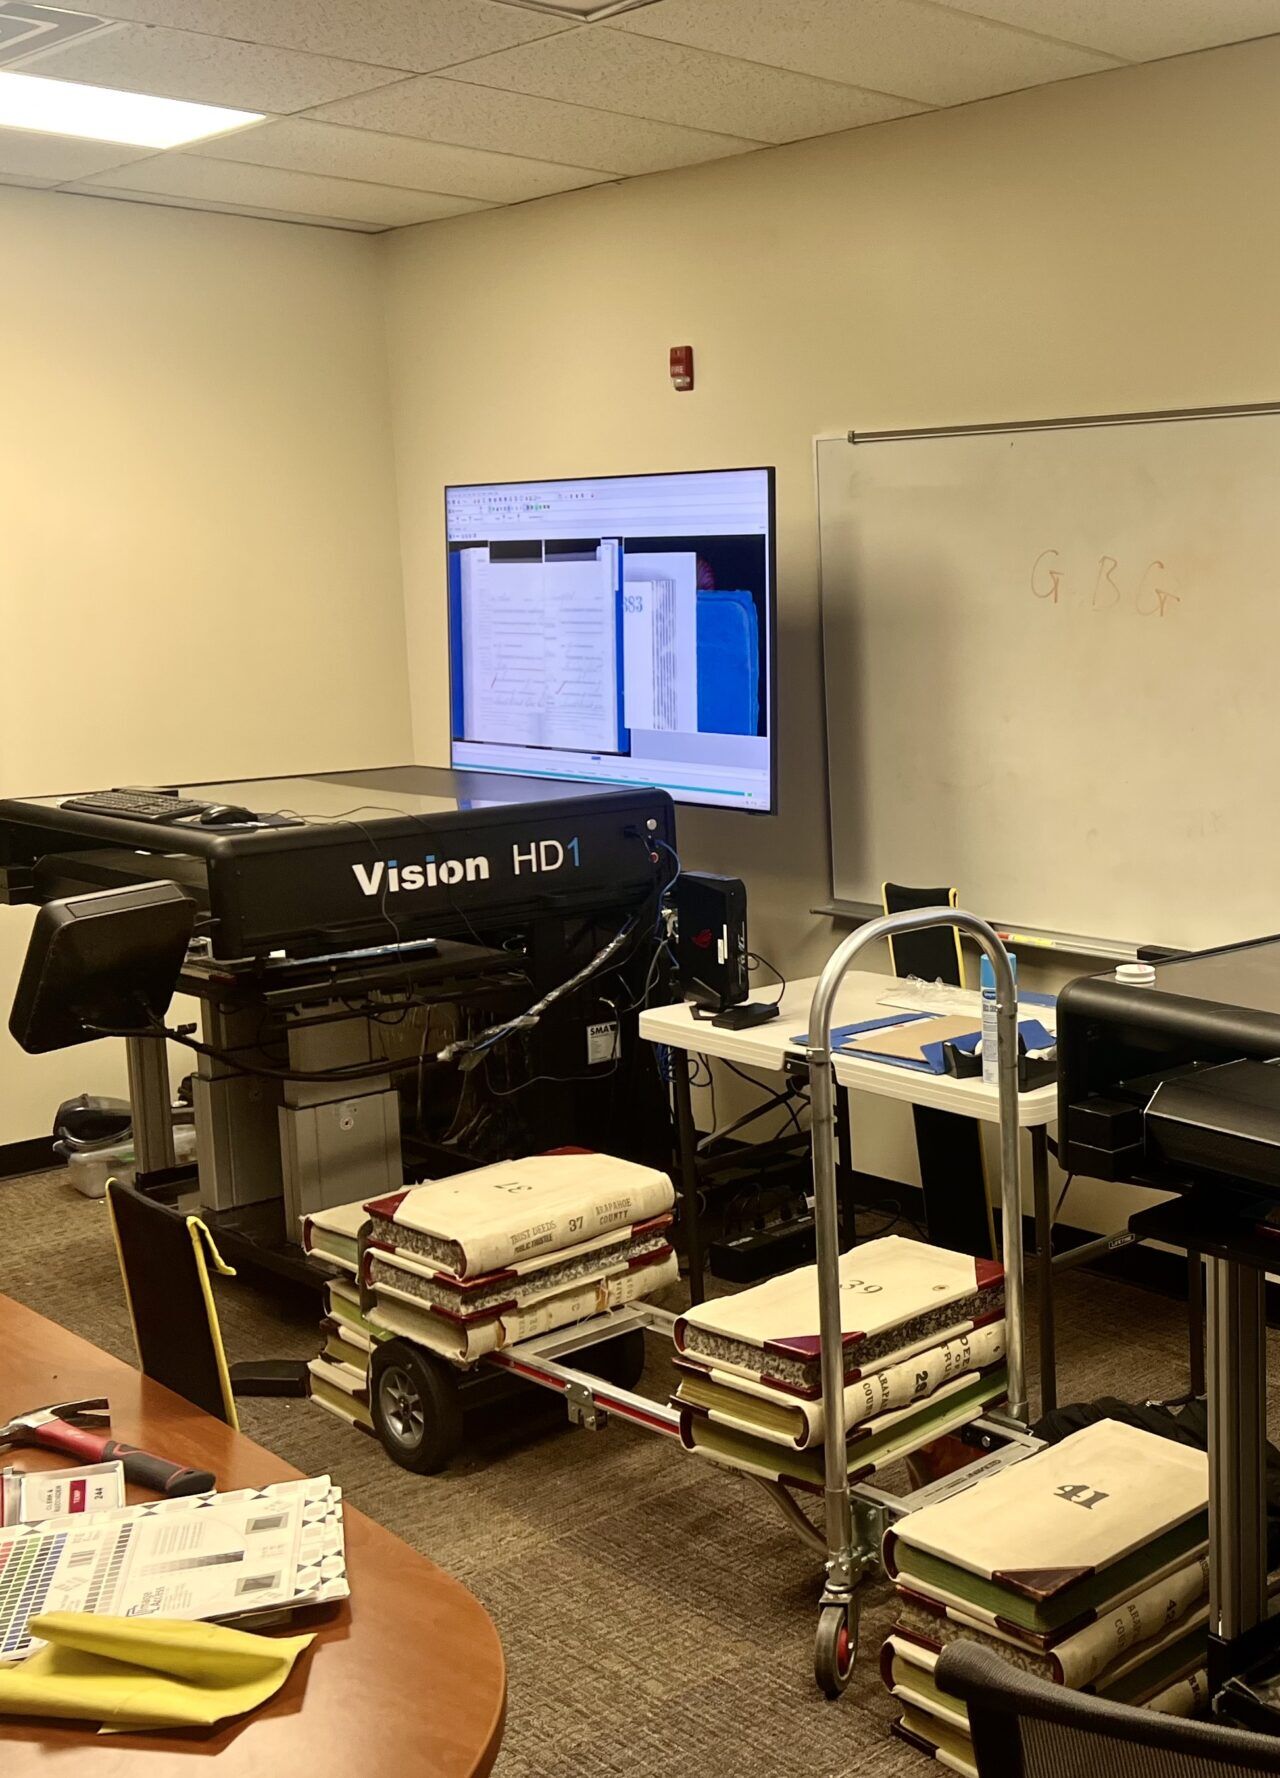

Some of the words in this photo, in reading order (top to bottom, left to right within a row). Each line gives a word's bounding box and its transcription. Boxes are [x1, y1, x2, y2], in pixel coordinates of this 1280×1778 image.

[351, 854, 490, 896] Vision
[512, 836, 582, 876] HD1
[532, 1220, 558, 1237] DEEDS
[568, 1215, 584, 1233] 37
[599, 1210, 629, 1226] COUNTY
[839, 1279, 884, 1294] 39
[943, 1343, 953, 1380] TRU
[959, 1336, 972, 1371] DEE
[1053, 1483, 1111, 1510] 41
